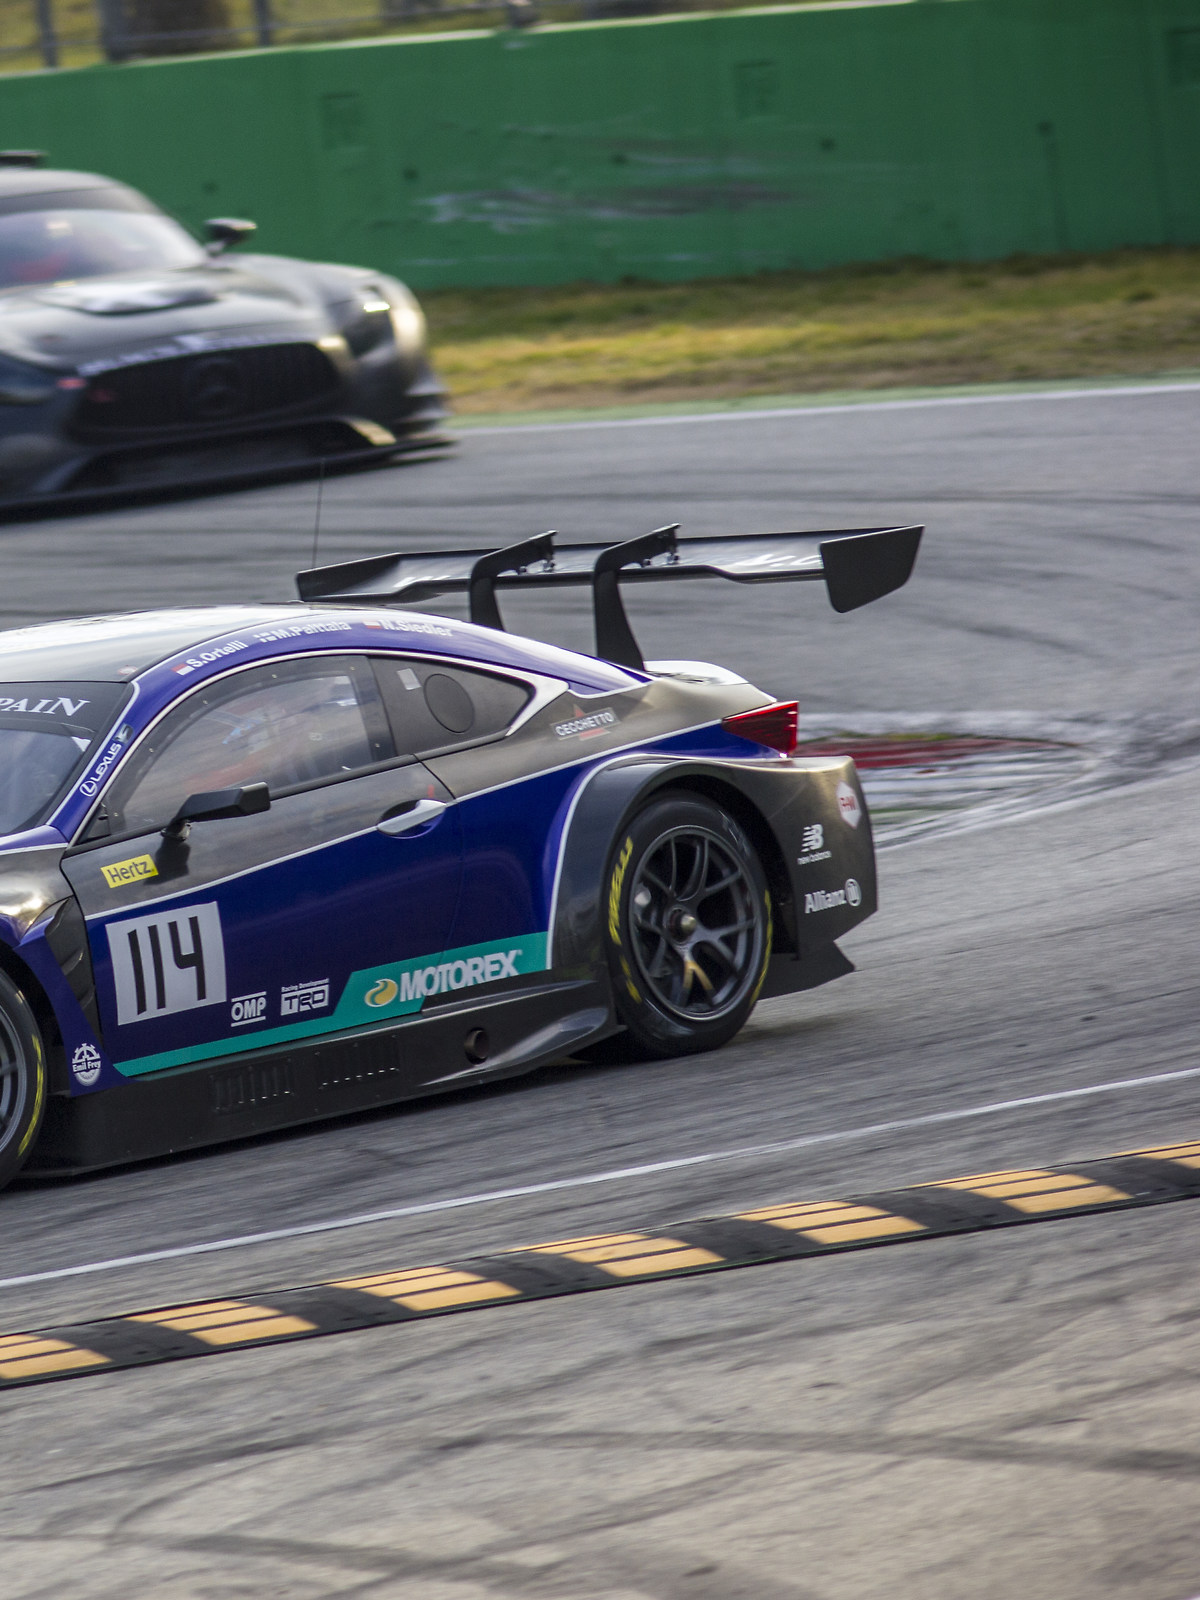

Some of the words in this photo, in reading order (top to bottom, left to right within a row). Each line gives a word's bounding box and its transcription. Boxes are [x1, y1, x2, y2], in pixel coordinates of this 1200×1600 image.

[186, 640, 249, 669] S.Ortelli
[555, 712, 615, 736] CECCHETTO
[90, 743, 122, 782] LEXUS
[107, 861, 151, 883] Hertz
[804, 889, 847, 914] Allianz
[127, 916, 207, 1015] 114
[400, 949, 521, 1003] MOTOREX
[231, 997, 267, 1021] OMP
[282, 987, 329, 1014] TRD
